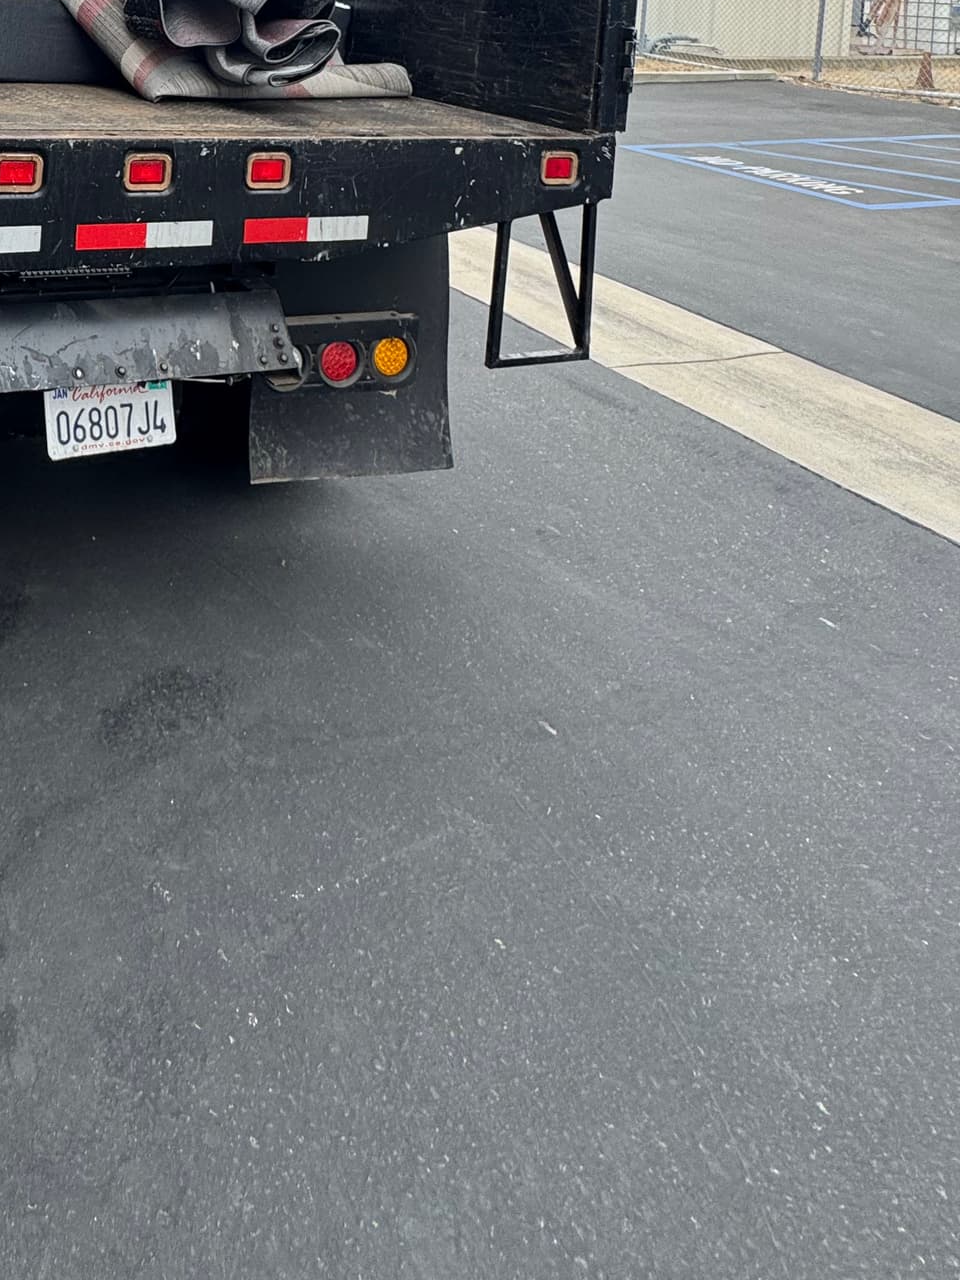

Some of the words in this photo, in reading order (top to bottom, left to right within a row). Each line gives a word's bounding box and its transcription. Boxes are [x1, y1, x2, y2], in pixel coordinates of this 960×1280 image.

[732, 165, 865, 195] PARKING
[52, 388, 68, 400] JAN
[71, 384, 148, 403] California
[56, 400, 166, 445] 06807J4
